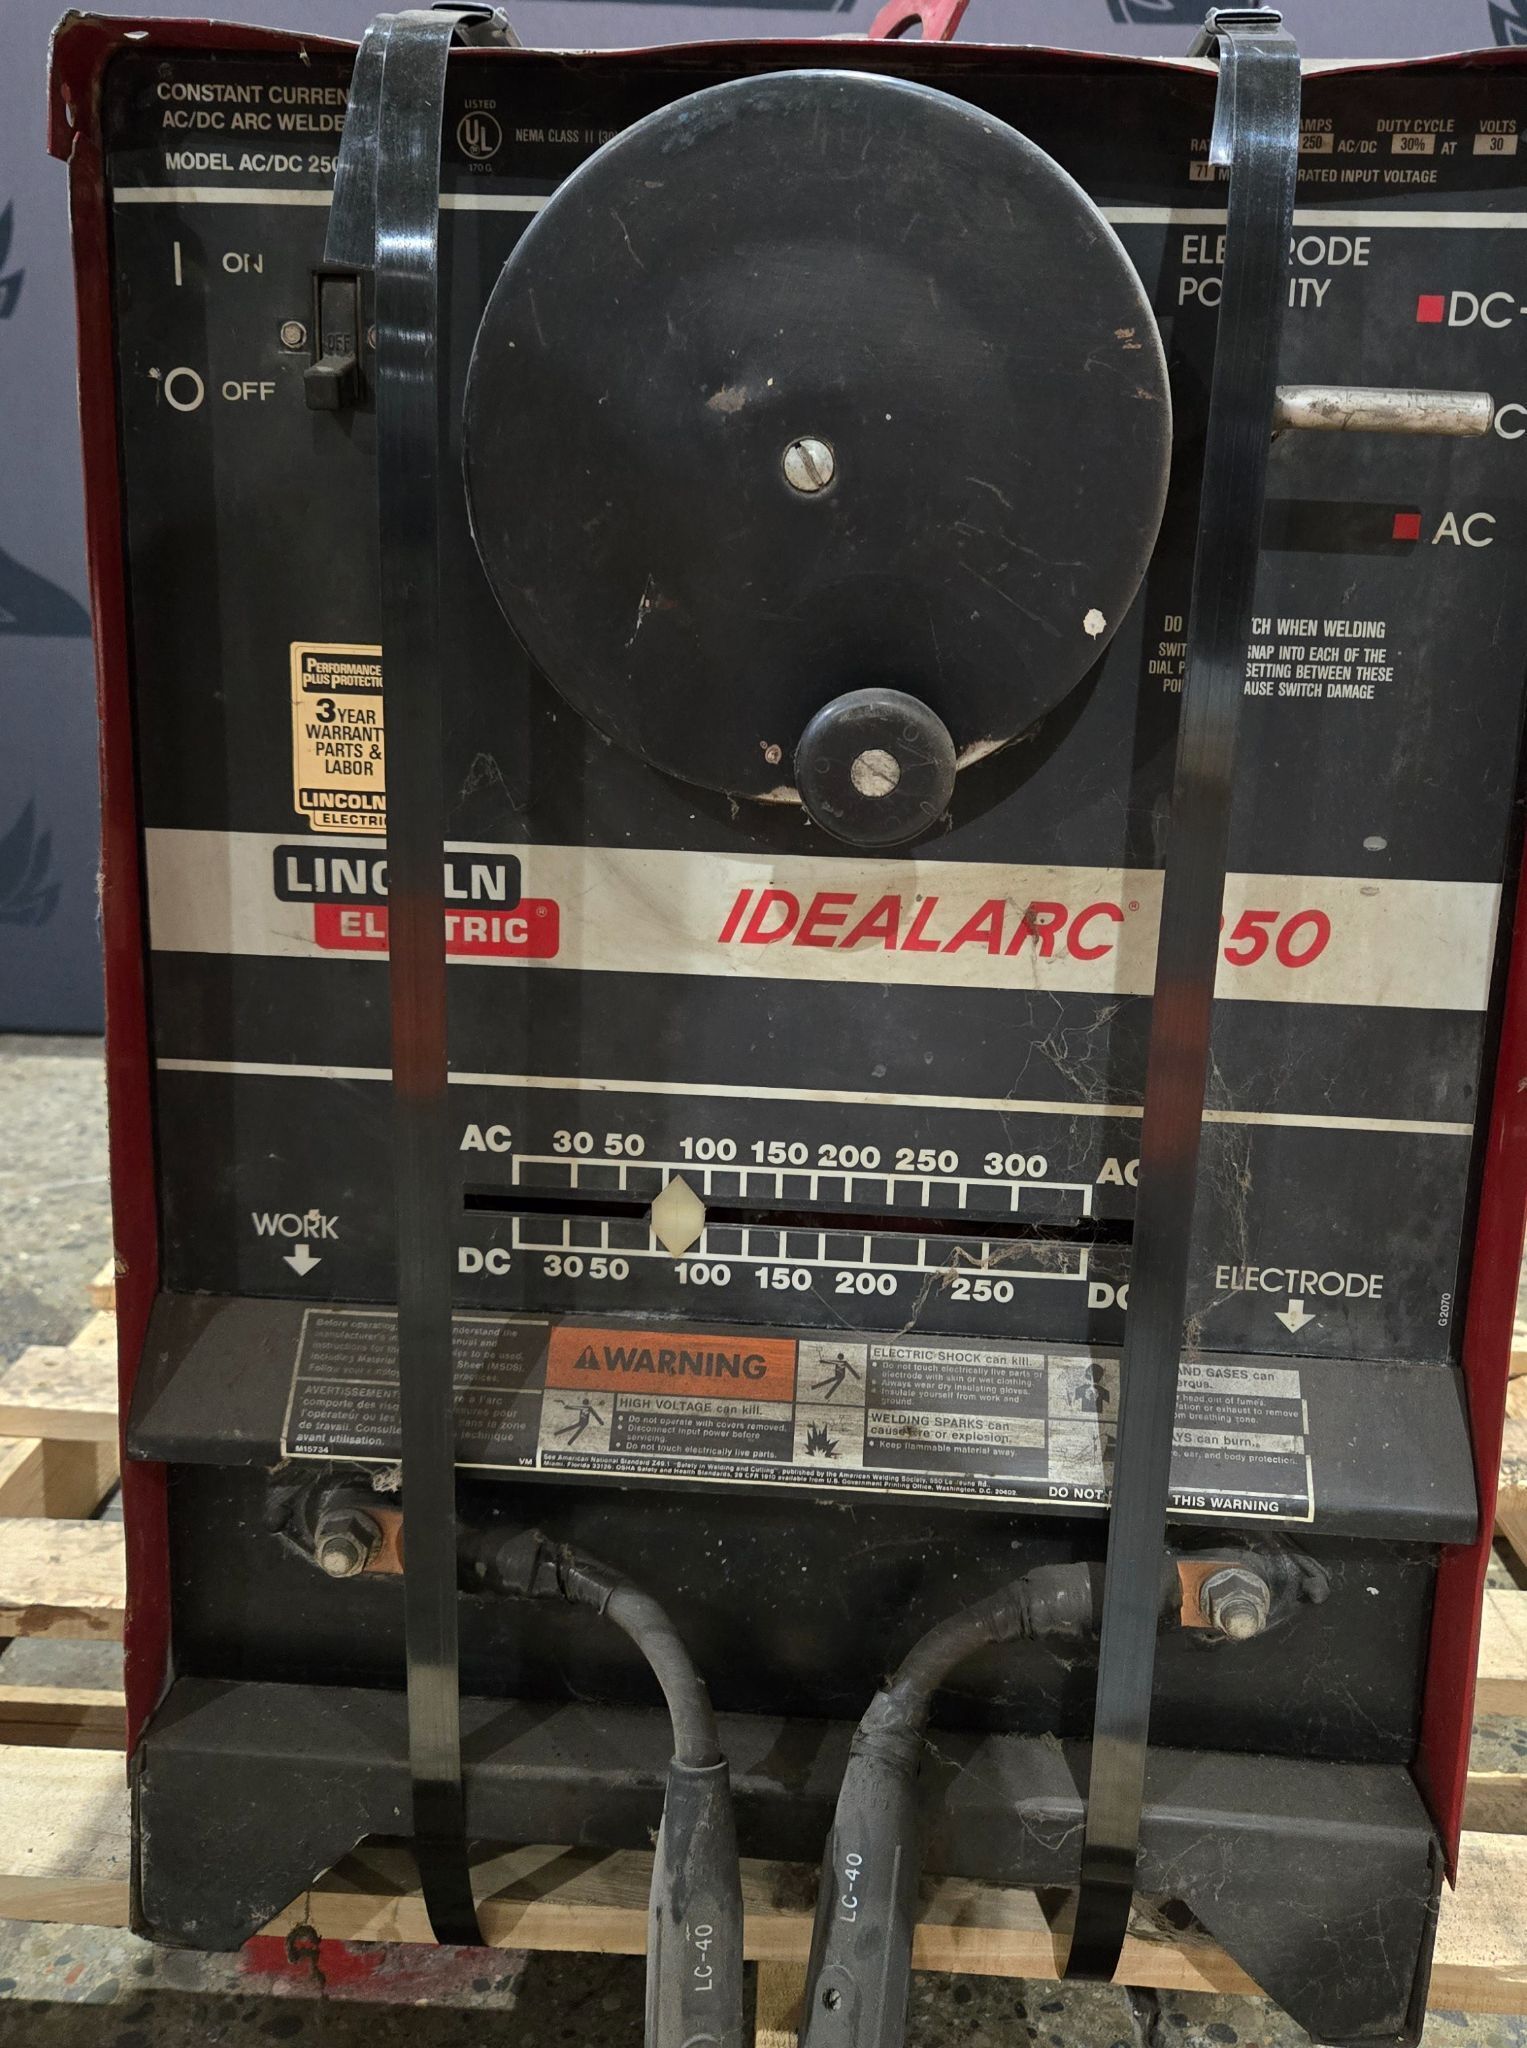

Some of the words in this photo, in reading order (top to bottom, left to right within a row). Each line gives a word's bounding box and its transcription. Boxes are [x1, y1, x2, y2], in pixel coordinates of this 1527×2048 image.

[157, 82, 263, 104] CONSTANT
[269, 85, 350, 106] CURREN
[464, 99, 496, 110] LISTED
[162, 109, 225, 129] AC/DC
[231, 112, 271, 131] ARC
[277, 113, 346, 132] WELDE
[1376, 119, 1411, 133] DUTY
[1414, 119, 1456, 134] CYCLE
[1479, 120, 1517, 134] VOLTS
[515, 128, 545, 143] NEMA
[548, 129, 579, 143] CLASS
[1302, 136, 1323, 149] 250
[1337, 140, 1378, 154] AC/DC
[1400, 137, 1426, 152] 30%
[1440, 142, 1459, 156] AT
[1490, 137, 1504, 151] 30
[165, 150, 235, 172] MODEL
[238, 153, 303, 173] AC/DC
[1298, 169, 1338, 183] RATED
[1340, 169, 1380, 183] INPUT
[1384, 169, 1439, 184] VOLTAGE
[222, 252, 264, 275] ON
[1177, 276, 1333, 308] POITY
[222, 380, 276, 401] OFF
[1431, 511, 1497, 548] AC
[1164, 615, 1183, 633] DO
[1277, 618, 1318, 637] WHEN
[1323, 619, 1387, 639] WELDING
[1279, 645, 1305, 661] INTO
[1309, 646, 1340, 662] EACH
[1344, 647, 1359, 663] OF
[1364, 648, 1387, 664] THE
[308, 657, 383, 676] PERFORMANCE
[1149, 659, 1173, 675] DIAL
[1296, 663, 1351, 681] BETWEEN
[1355, 665, 1394, 682] THESE
[303, 673, 331, 689] PLUS
[1243, 681, 1273, 697] AUSE
[1277, 682, 1322, 699] SWITCH
[1326, 683, 1376, 700] DAMAGE
[315, 697, 336, 724] 3
[336, 707, 375, 725] YEAR
[305, 722, 384, 743] WARRANT
[315, 741, 364, 760] PARTS
[369, 743, 382, 761] &
[325, 758, 374, 776] LABOR
[301, 791, 386, 811] LINCOLN
[322, 812, 387, 827] ELECTRI
[717, 888, 1125, 962] IDEALARC
[1221, 908, 1332, 969] 50
[460, 1124, 512, 1153] AC
[553, 1130, 594, 1154] 30
[604, 1132, 645, 1156] 50
[679, 1136, 737, 1161] 100
[751, 1140, 808, 1164] 150
[818, 1144, 880, 1169] 200
[895, 1148, 959, 1173] 250
[984, 1152, 1048, 1178] 300
[251, 1212, 340, 1240] WORK
[458, 1246, 512, 1275] DC
[543, 1254, 583, 1278] 30
[589, 1257, 630, 1281] 50
[674, 1262, 731, 1286] 100
[755, 1266, 812, 1291] 150
[835, 1271, 897, 1296] 200
[951, 1278, 1014, 1303] 250
[1215, 1264, 1384, 1299] ELECTRODE
[1437, 1292, 1452, 1328] G2070
[603, 1345, 768, 1380] WARNING
[873, 1347, 934, 1361] ELECTRIC
[937, 1350, 981, 1364] SHOCK
[985, 1355, 1007, 1365] can
[1011, 1356, 1033, 1367] kill.
[1205, 1367, 1249, 1380] GASES
[1252, 1371, 1275, 1382] can
[619, 1397, 651, 1409] HIGH
[656, 1399, 712, 1412] VOLTAGE
[716, 1404, 737, 1414] can
[742, 1404, 763, 1415] kill.
[628, 1424, 676, 1435] Disconnect
[702, 1429, 730, 1440] power
[732, 1429, 761, 1440] before
[629, 1414, 642, 1423] Do
[643, 1416, 658, 1424] not
[660, 1417, 693, 1427] operate
[695, 1419, 713, 1428] with
[716, 1421, 745, 1431] covers
[871, 1412, 930, 1426] WELDING
[934, 1416, 984, 1430] SPARKS
[987, 1421, 1010, 1432] can
[934, 1430, 948, 1439] or
[1196, 1434, 1219, 1445] can
[626, 1442, 639, 1450] Do
[640, 1443, 656, 1451] not
[657, 1444, 682, 1453] touch
[684, 1446, 733, 1457] electrically
[734, 1448, 750, 1457] live
[879, 1440, 902, 1451] Keep
[904, 1442, 951, 1453] flammable
[953, 1445, 990, 1455] material
[518, 1457, 533, 1466] VM
[1048, 1486, 1069, 1499] DO
[1073, 1487, 1104, 1501] NOT
[1172, 1494, 1206, 1507] THIS
[1209, 1496, 1279, 1513] WARNING
[840, 1852, 862, 1923] LC-40
[694, 1923, 713, 1991] LC-40
